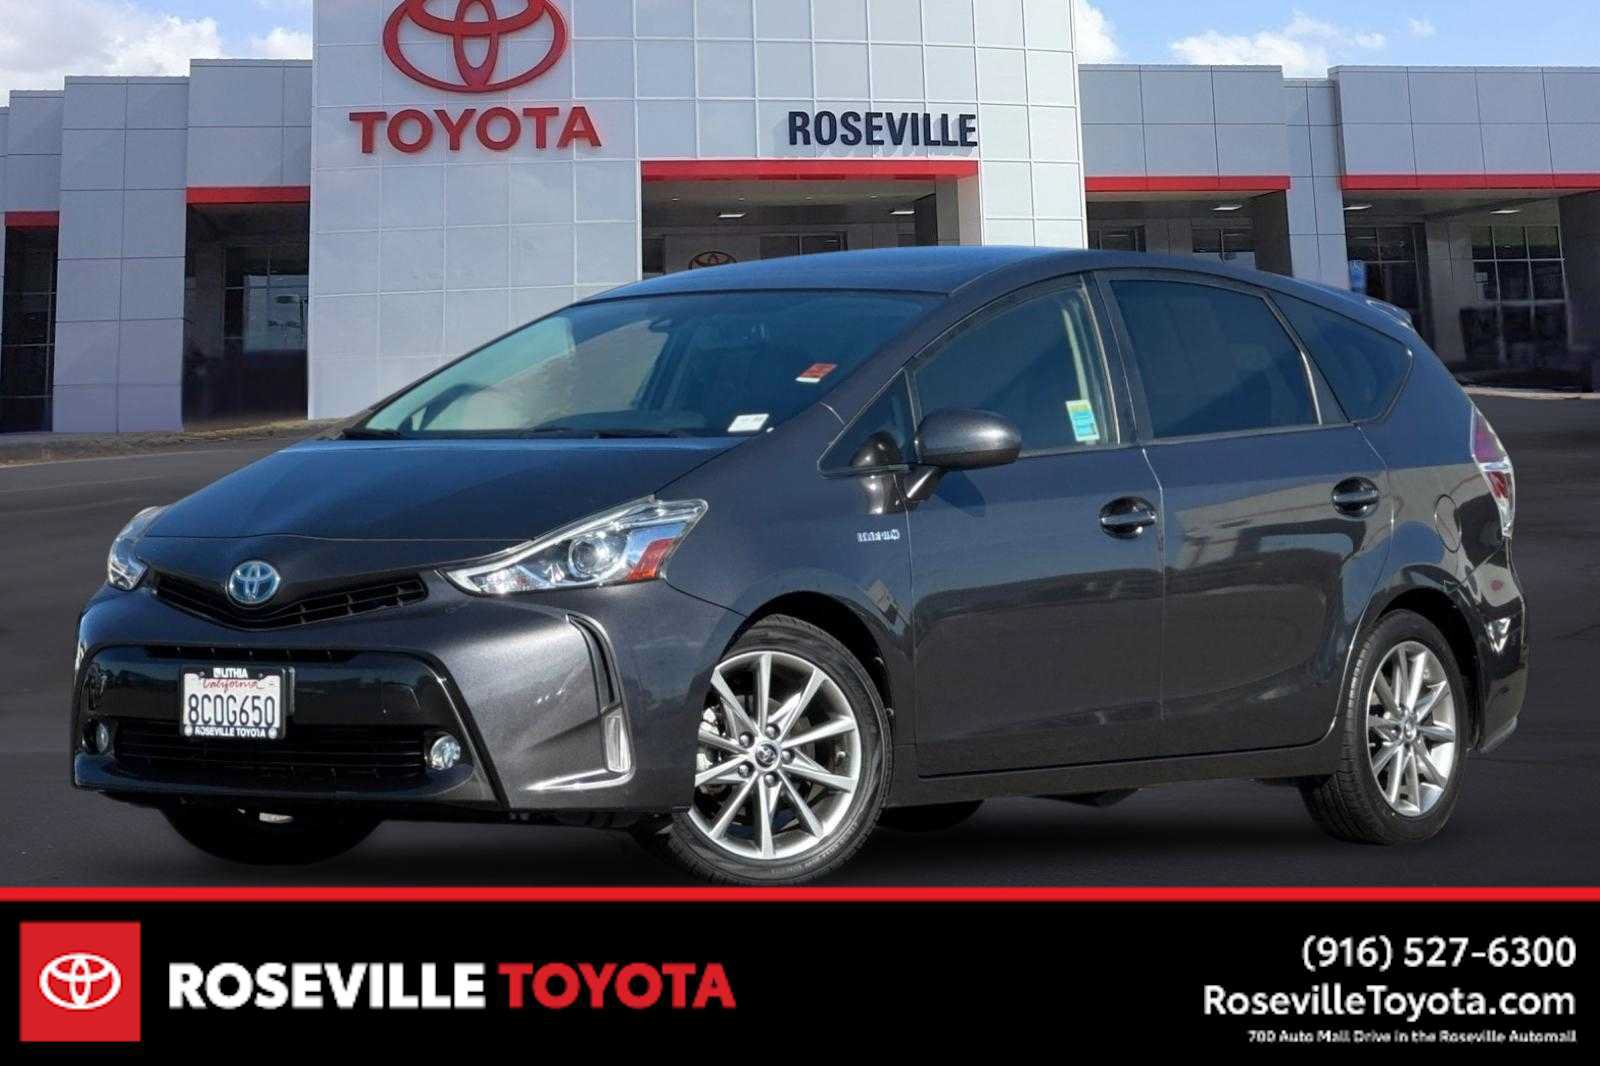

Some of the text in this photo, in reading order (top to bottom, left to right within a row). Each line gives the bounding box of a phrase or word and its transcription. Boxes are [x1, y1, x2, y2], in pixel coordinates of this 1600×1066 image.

[349, 106, 602, 154] TOYOTA
[788, 110, 978, 147] ROSEVILLE
[220, 667, 248, 679] LITHIA
[194, 727, 267, 738] ROSEVILLE TOYOTA
